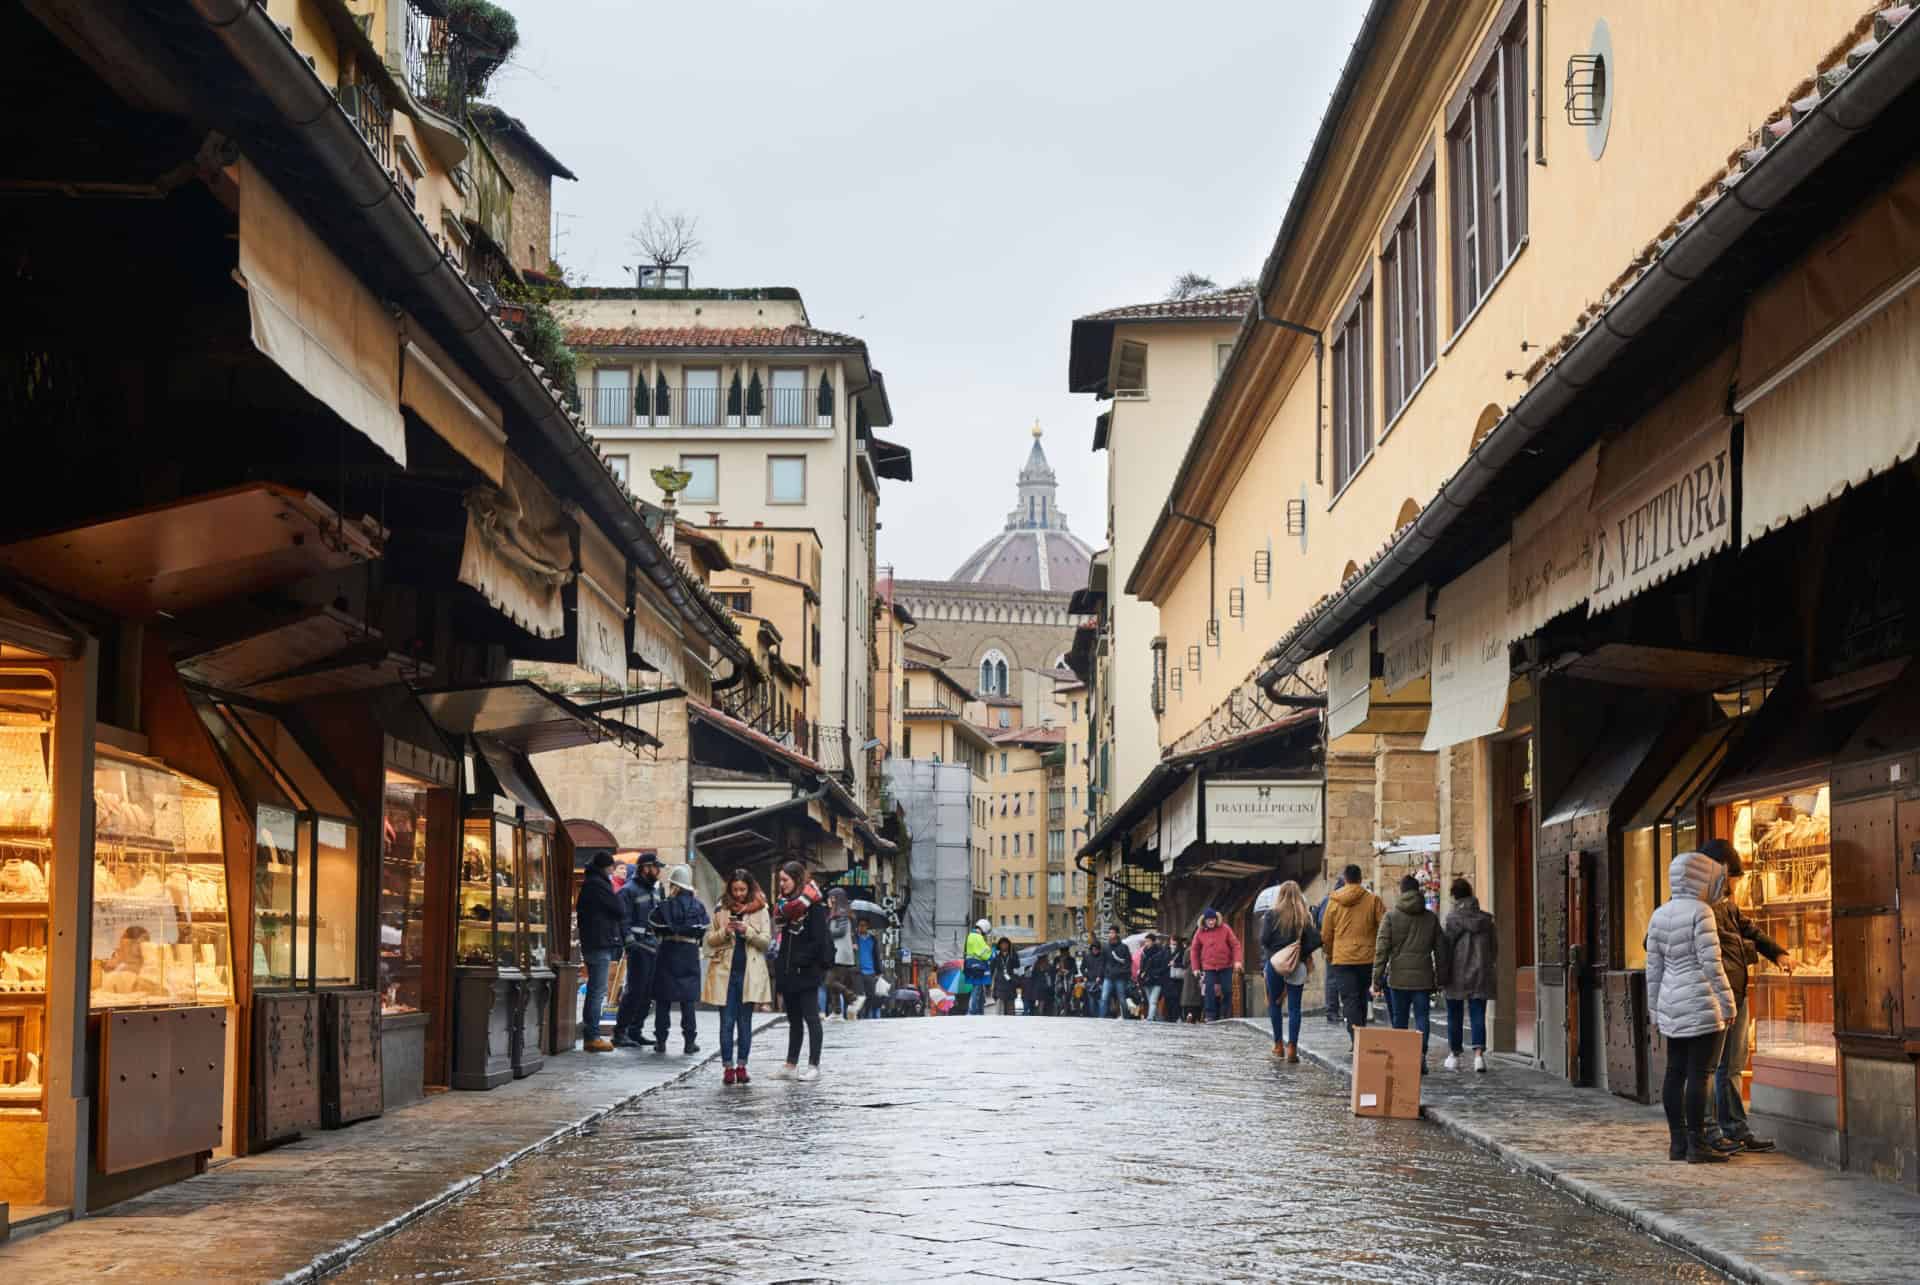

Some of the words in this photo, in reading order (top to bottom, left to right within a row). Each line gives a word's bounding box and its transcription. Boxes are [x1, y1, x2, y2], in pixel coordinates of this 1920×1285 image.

[1616, 449, 1728, 581] VETTORI
[1215, 802, 1270, 814] FRATELLI
[1271, 802, 1314, 814] PICCINI
